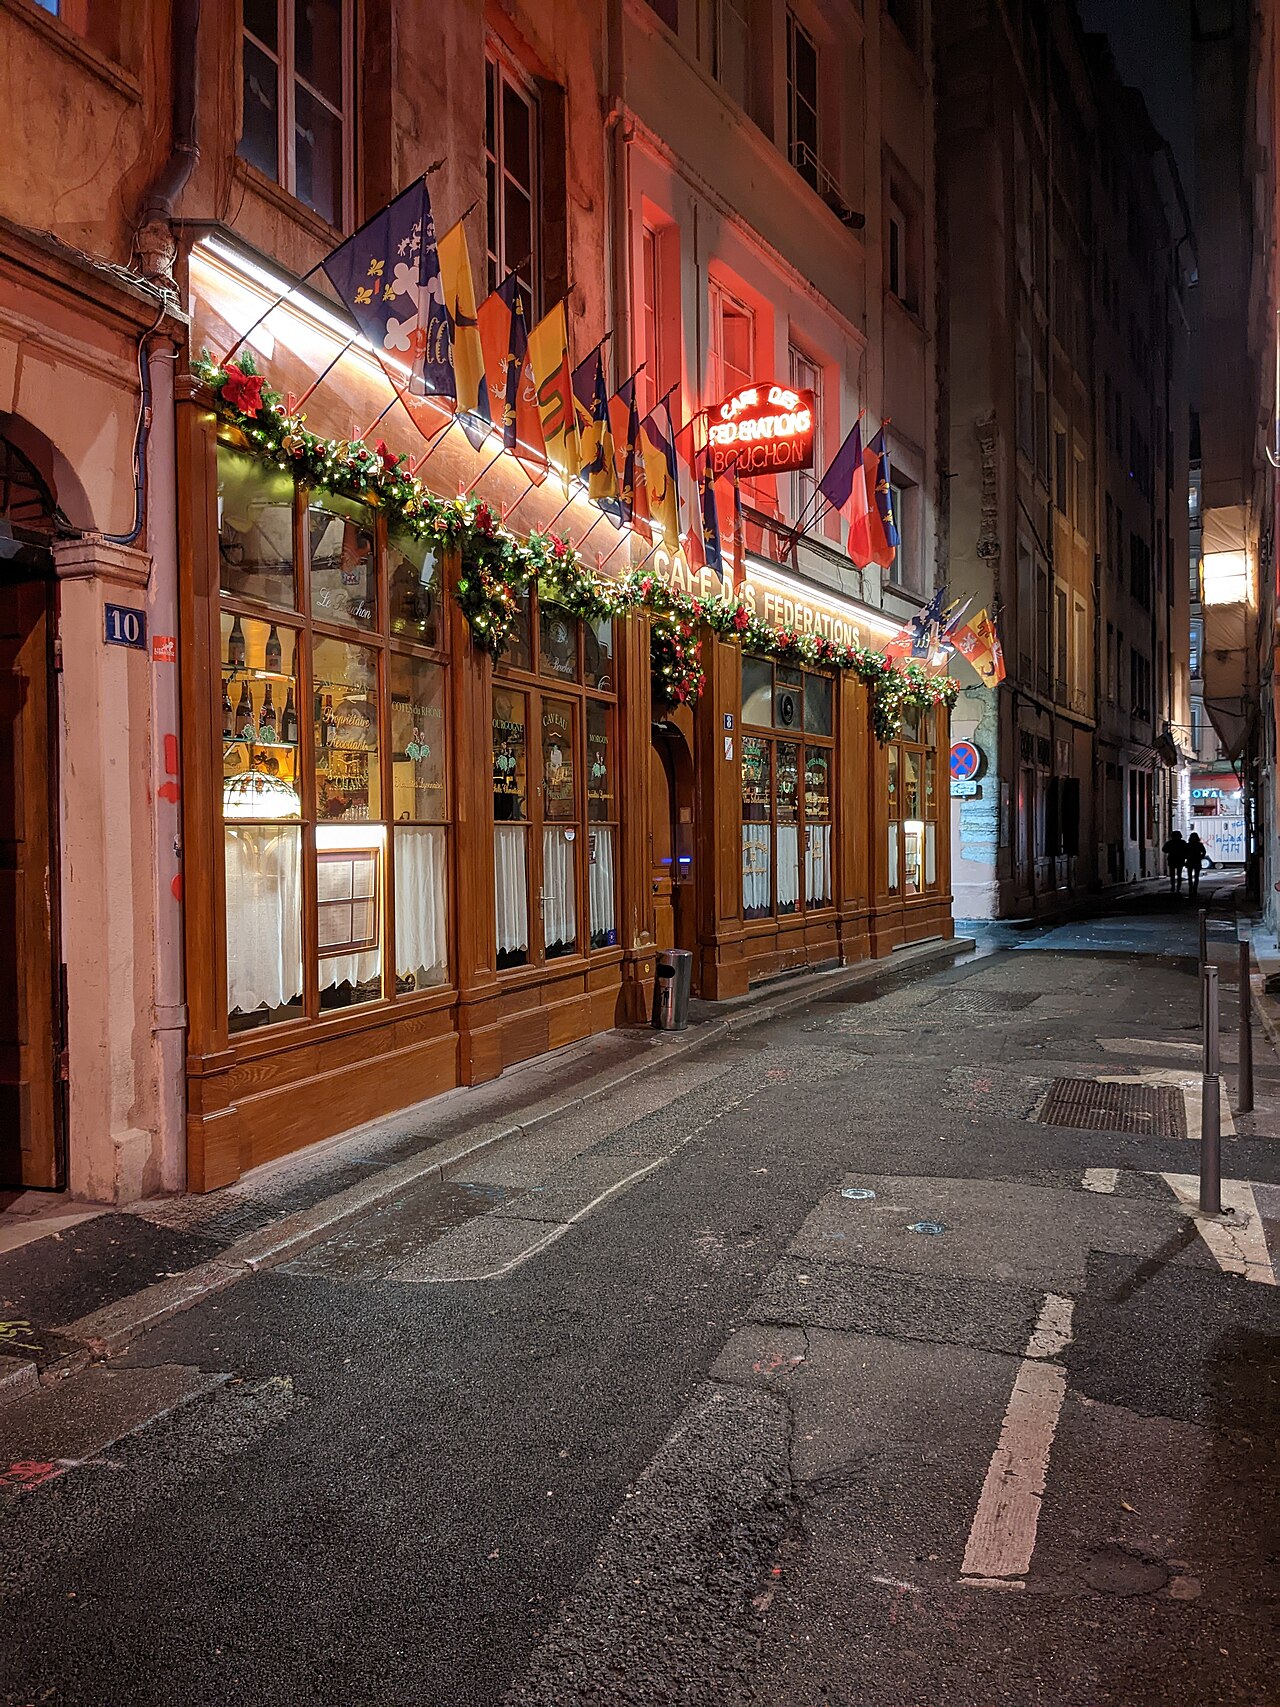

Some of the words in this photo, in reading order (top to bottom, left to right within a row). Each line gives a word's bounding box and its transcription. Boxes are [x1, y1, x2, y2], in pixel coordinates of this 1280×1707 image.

[714, 440, 806, 473] BOUCHON
[316, 587, 331, 608] Le
[111, 609, 140, 642] 10
[492, 718, 523, 733] OURGOGNE
[542, 713, 568, 731] CAVEAU
[726, 715, 732, 728] 8
